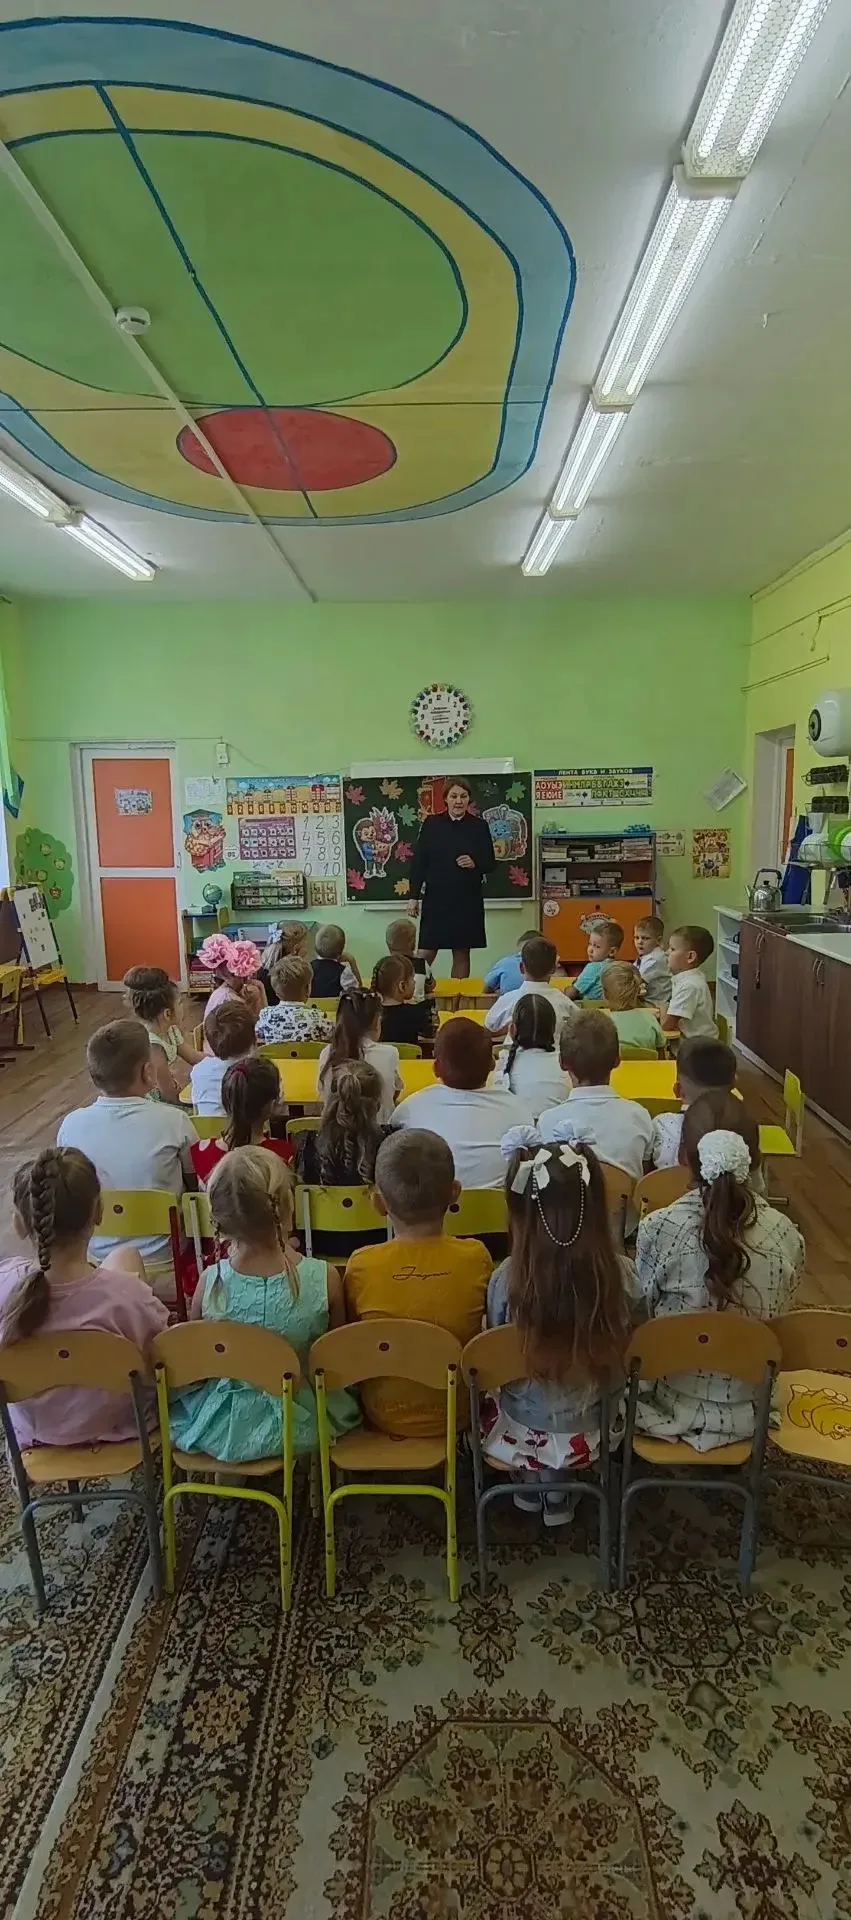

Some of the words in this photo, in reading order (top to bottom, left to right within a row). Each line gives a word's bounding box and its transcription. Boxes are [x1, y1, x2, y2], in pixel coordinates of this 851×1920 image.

[303, 816, 309, 829] 1
[316, 815, 325, 829] 2
[332, 815, 340, 829] 3
[302, 831, 311, 846] 4
[316, 831, 326, 846] 5
[331, 831, 341, 845] 6
[302, 847, 311, 860] 7
[317, 846, 326, 861] 8
[333, 846, 341, 861] 9
[304, 862, 312, 877] 0
[323, 861, 341, 877] 10
